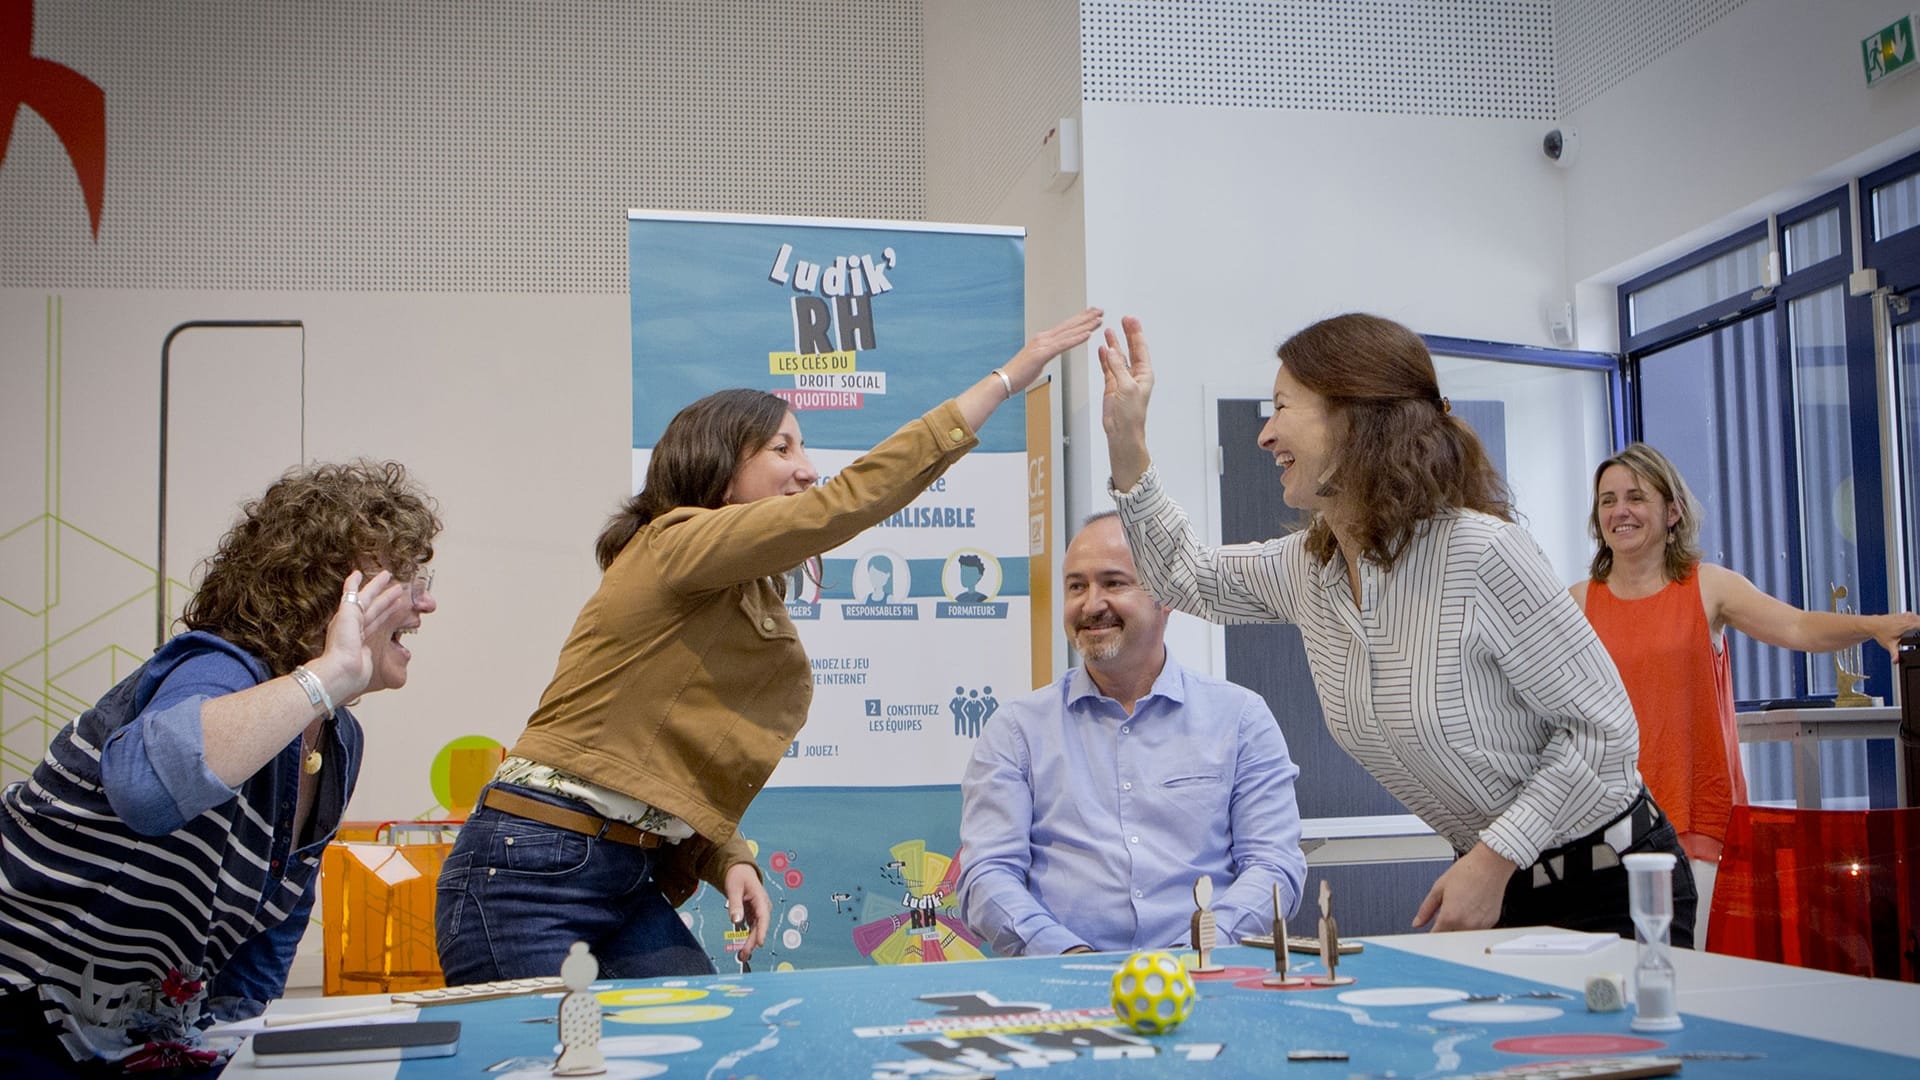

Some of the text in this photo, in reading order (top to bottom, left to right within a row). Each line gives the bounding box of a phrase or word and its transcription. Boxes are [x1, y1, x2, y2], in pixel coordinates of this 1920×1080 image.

[791, 295, 877, 354] RH
[779, 353, 848, 371] LES CLÉS DU
[800, 374, 881, 389] DROIT SOCIAL
[795, 391, 858, 409] QUOTIDIEN
[846, 604, 914, 617] RESPONSABLES RH
[948, 604, 996, 617] FORMATEURS
[841, 658, 851, 670] LE
[853, 657, 870, 670] JEU
[823, 672, 867, 685] INTERNET
[870, 702, 939, 716] 2 CONSTITUEZ
[869, 717, 922, 733] LES ÉQUIPES
[804, 745, 833, 757] JOUEZ
[911, 908, 937, 929] RH
